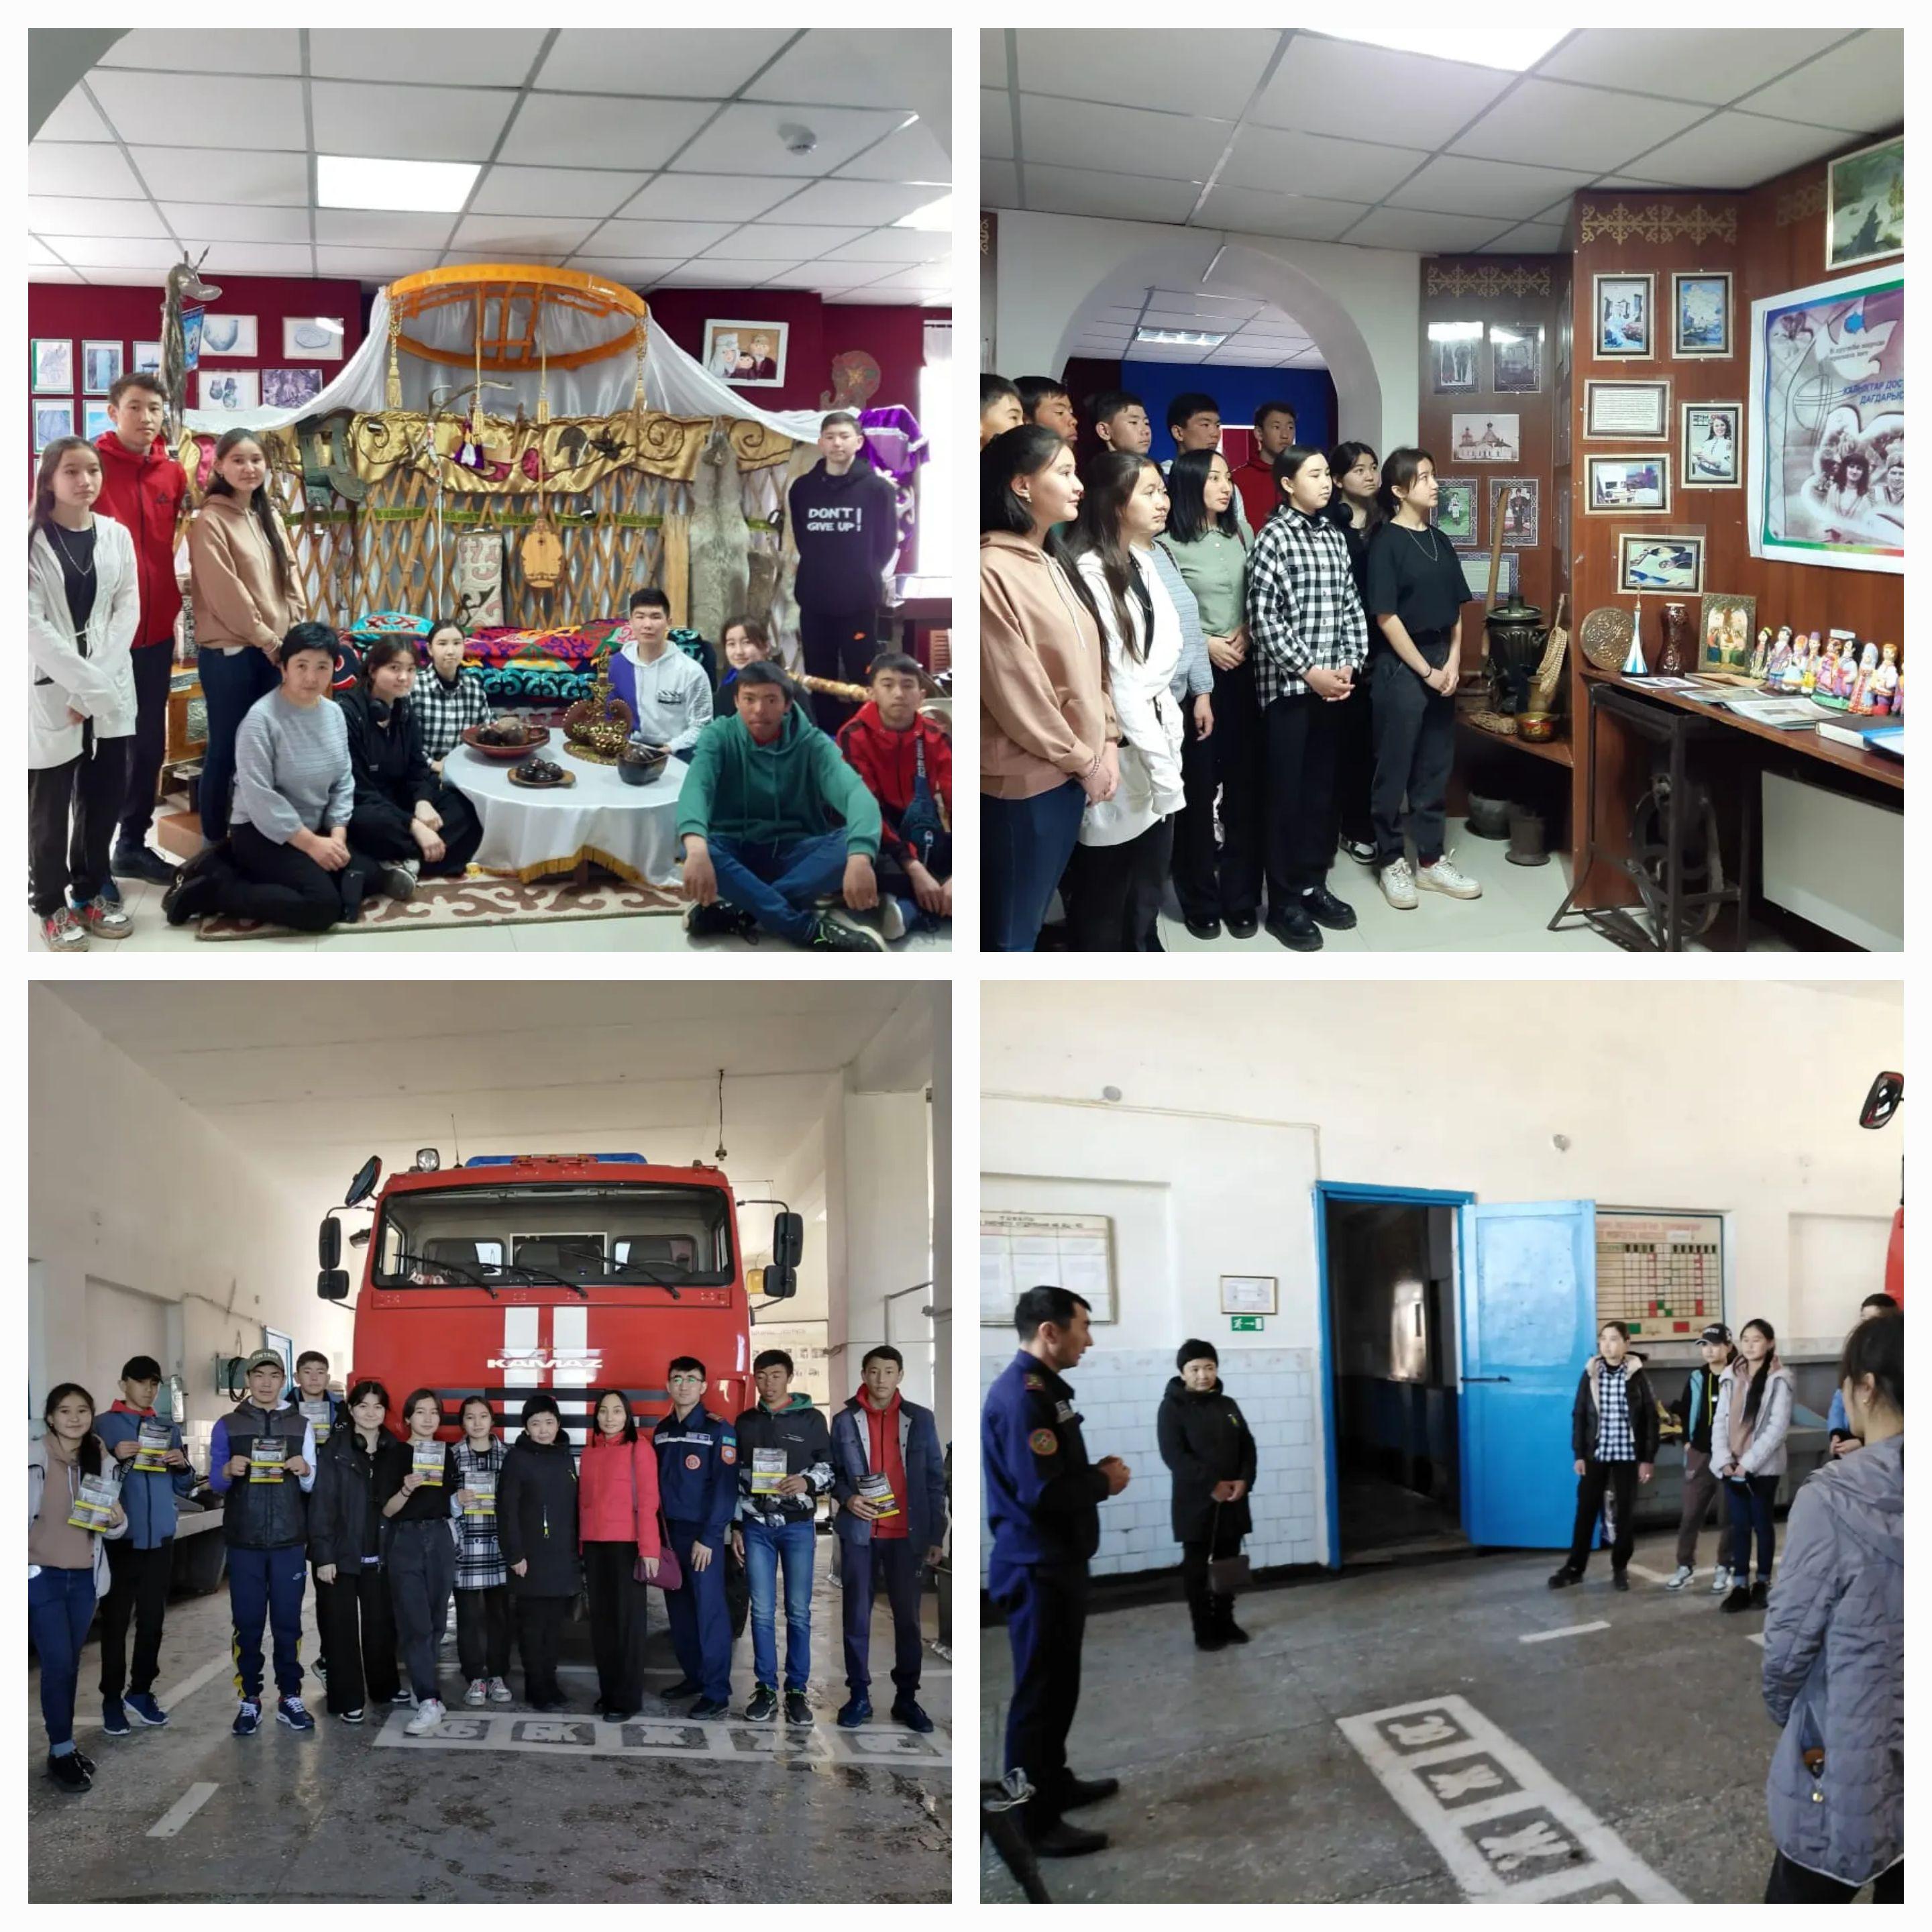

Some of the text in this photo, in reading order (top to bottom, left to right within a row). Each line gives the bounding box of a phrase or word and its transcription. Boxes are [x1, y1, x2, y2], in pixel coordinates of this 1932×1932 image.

[807, 522, 835, 531] GIVE
[487, 1359, 603, 1368] KAMAZ
[639, 1725, 688, 1746] Ж
